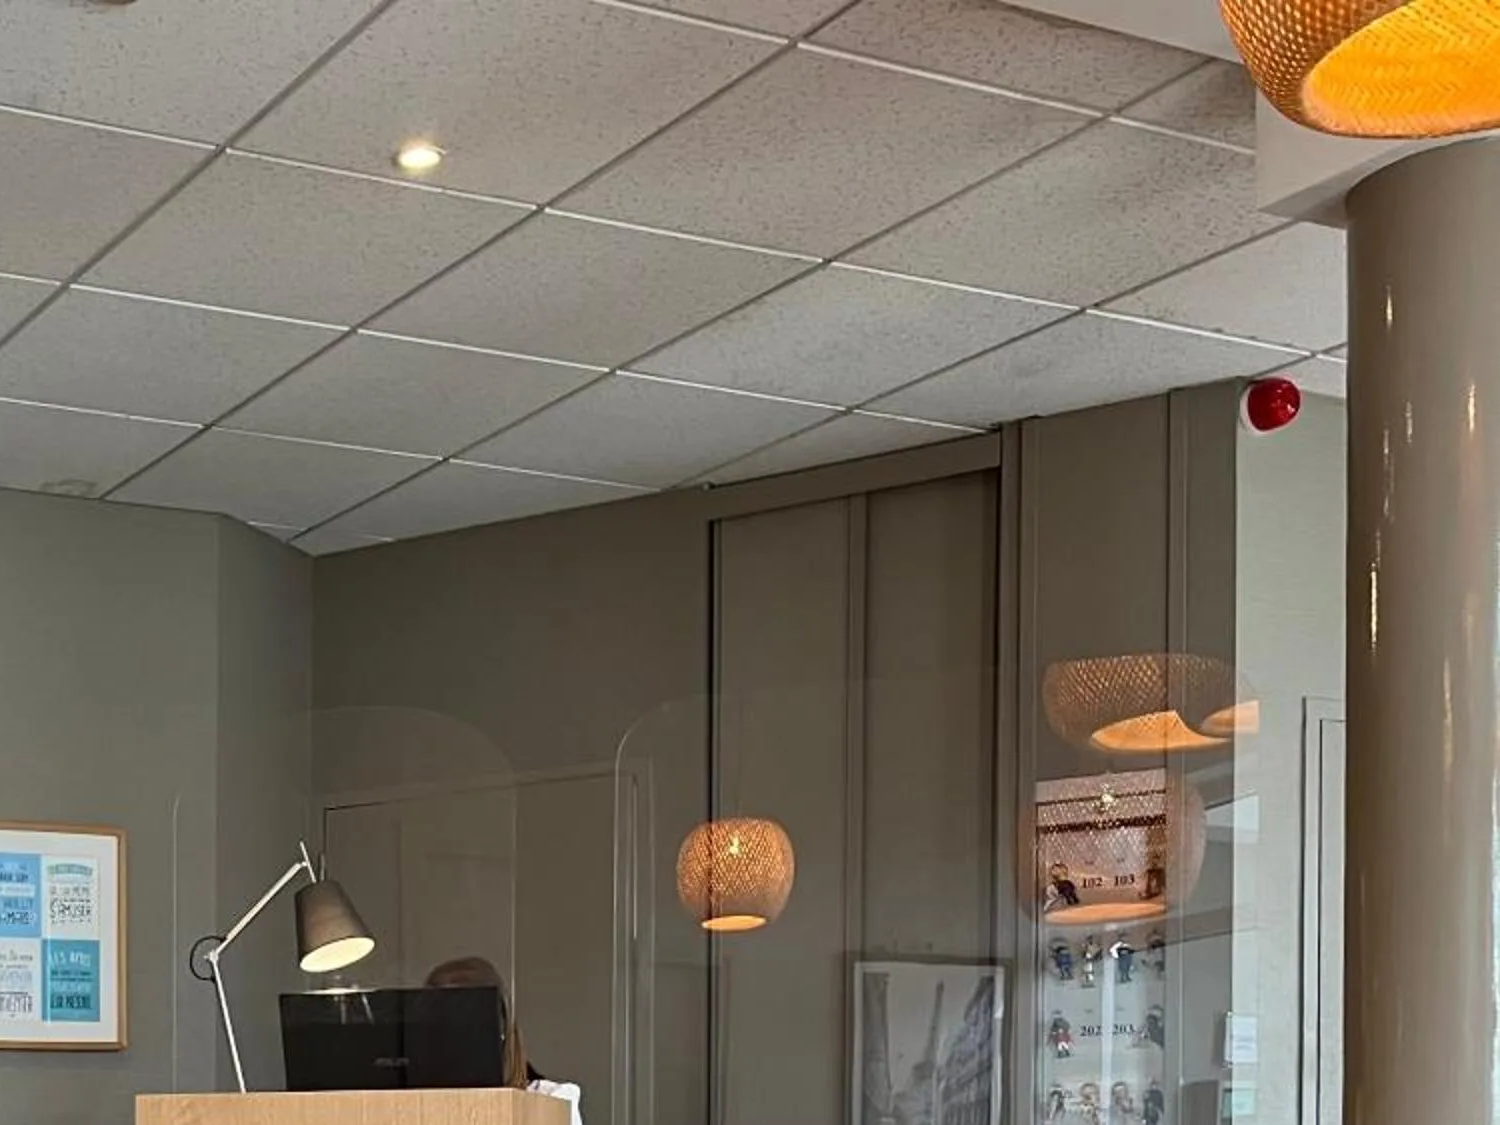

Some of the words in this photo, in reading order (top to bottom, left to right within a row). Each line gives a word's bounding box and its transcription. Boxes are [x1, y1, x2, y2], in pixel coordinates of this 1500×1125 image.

[1082, 876, 1103, 889] 102
[1114, 873, 1135, 887] 103
[1111, 1023, 1135, 1036] 203
